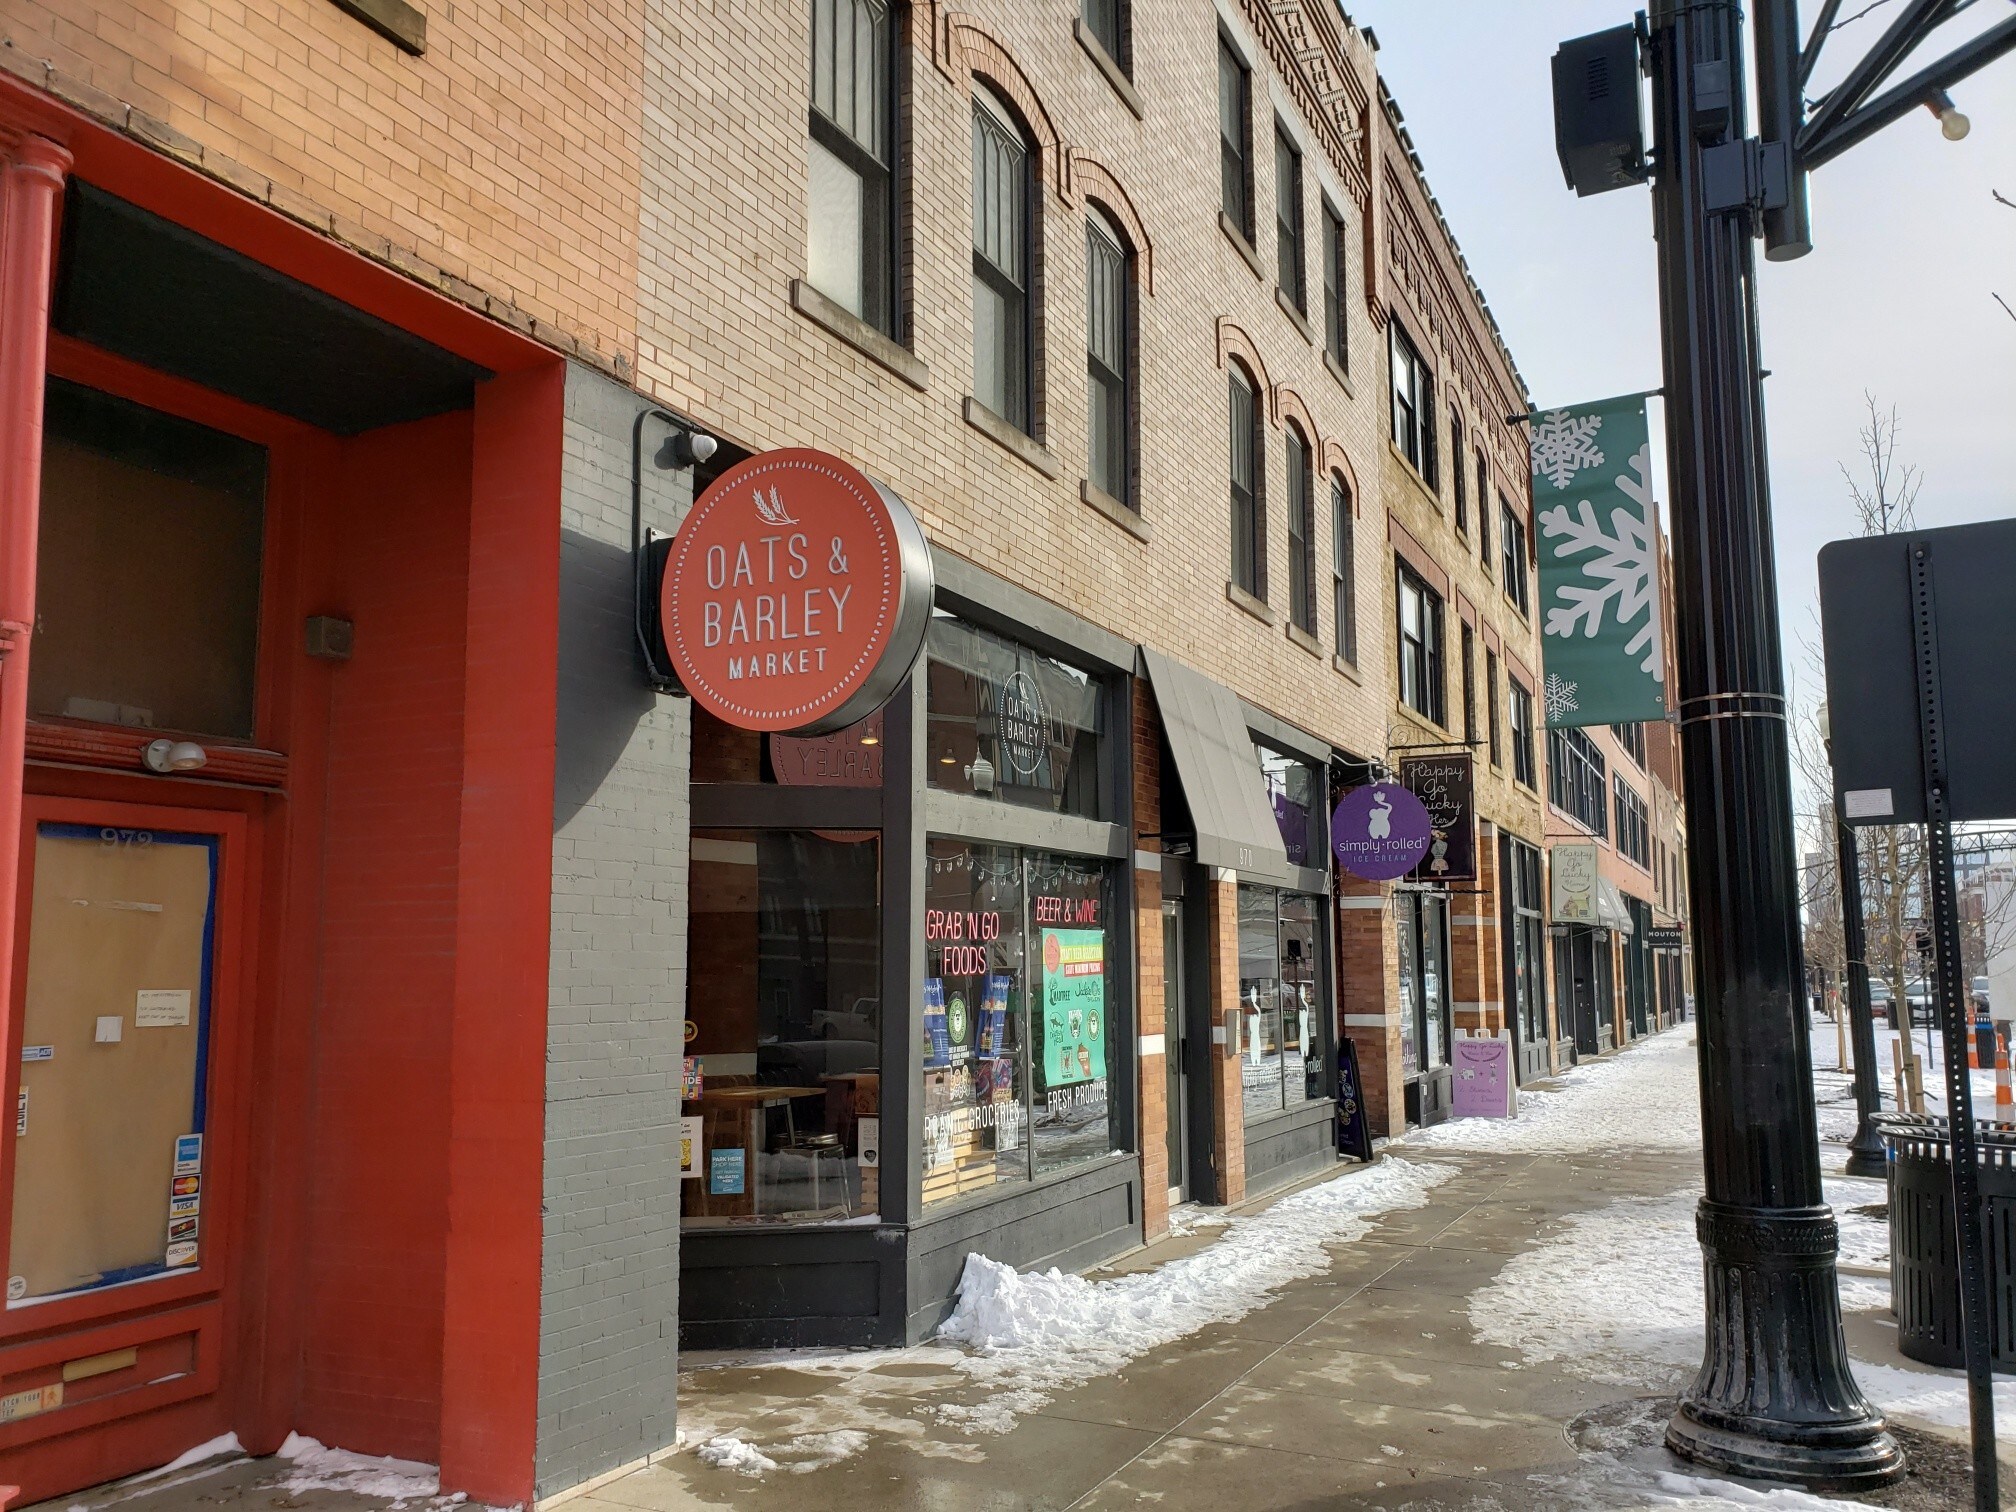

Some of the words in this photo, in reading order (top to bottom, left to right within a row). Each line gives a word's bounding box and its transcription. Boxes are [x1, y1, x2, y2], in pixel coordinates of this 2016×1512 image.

[706, 532, 809, 590] OATS
[828, 536, 850, 575] &
[703, 584, 853, 648] BARLEY
[728, 647, 828, 681] MARKET
[1008, 696, 1031, 722] OATS
[1033, 709, 1039, 725] &
[1007, 719, 1039, 747] BARLEY
[1013, 744, 1034, 760] MARKET
[1406, 761, 1465, 782] Happy
[1423, 778, 1447, 800] Go
[100, 828, 153, 851] 972
[1339, 839, 1380, 854] simply
[1239, 847, 1253, 867] 970
[1353, 855, 1369, 863] ICE
[1374, 854, 1408, 862] CREAM
[1556, 847, 1593, 861] Happy
[1560, 868, 1591, 882] Lucky
[1566, 858, 1582, 872] Go
[1036, 897, 1061, 922] BEER
[1064, 898, 1072, 922] &
[1075, 899, 1098, 923] WINE
[926, 910, 963, 940] GRAB
[981, 912, 999, 940] GO
[944, 947, 986, 975] FOODS
[682, 1076, 702, 1085] IDE
[1047, 1088, 1072, 1113] FRESH
[1075, 1080, 1108, 1106] PRODUCE
[923, 1111, 964, 1141] RGANIC
[968, 1098, 1020, 1131] GROCERIES
[176, 1201, 194, 1211] VISA
[168, 1245, 195, 1256] DISCOVER
[1, 1408, 15, 1418] TEP
[2, 1397, 20, 1408] ATCH
